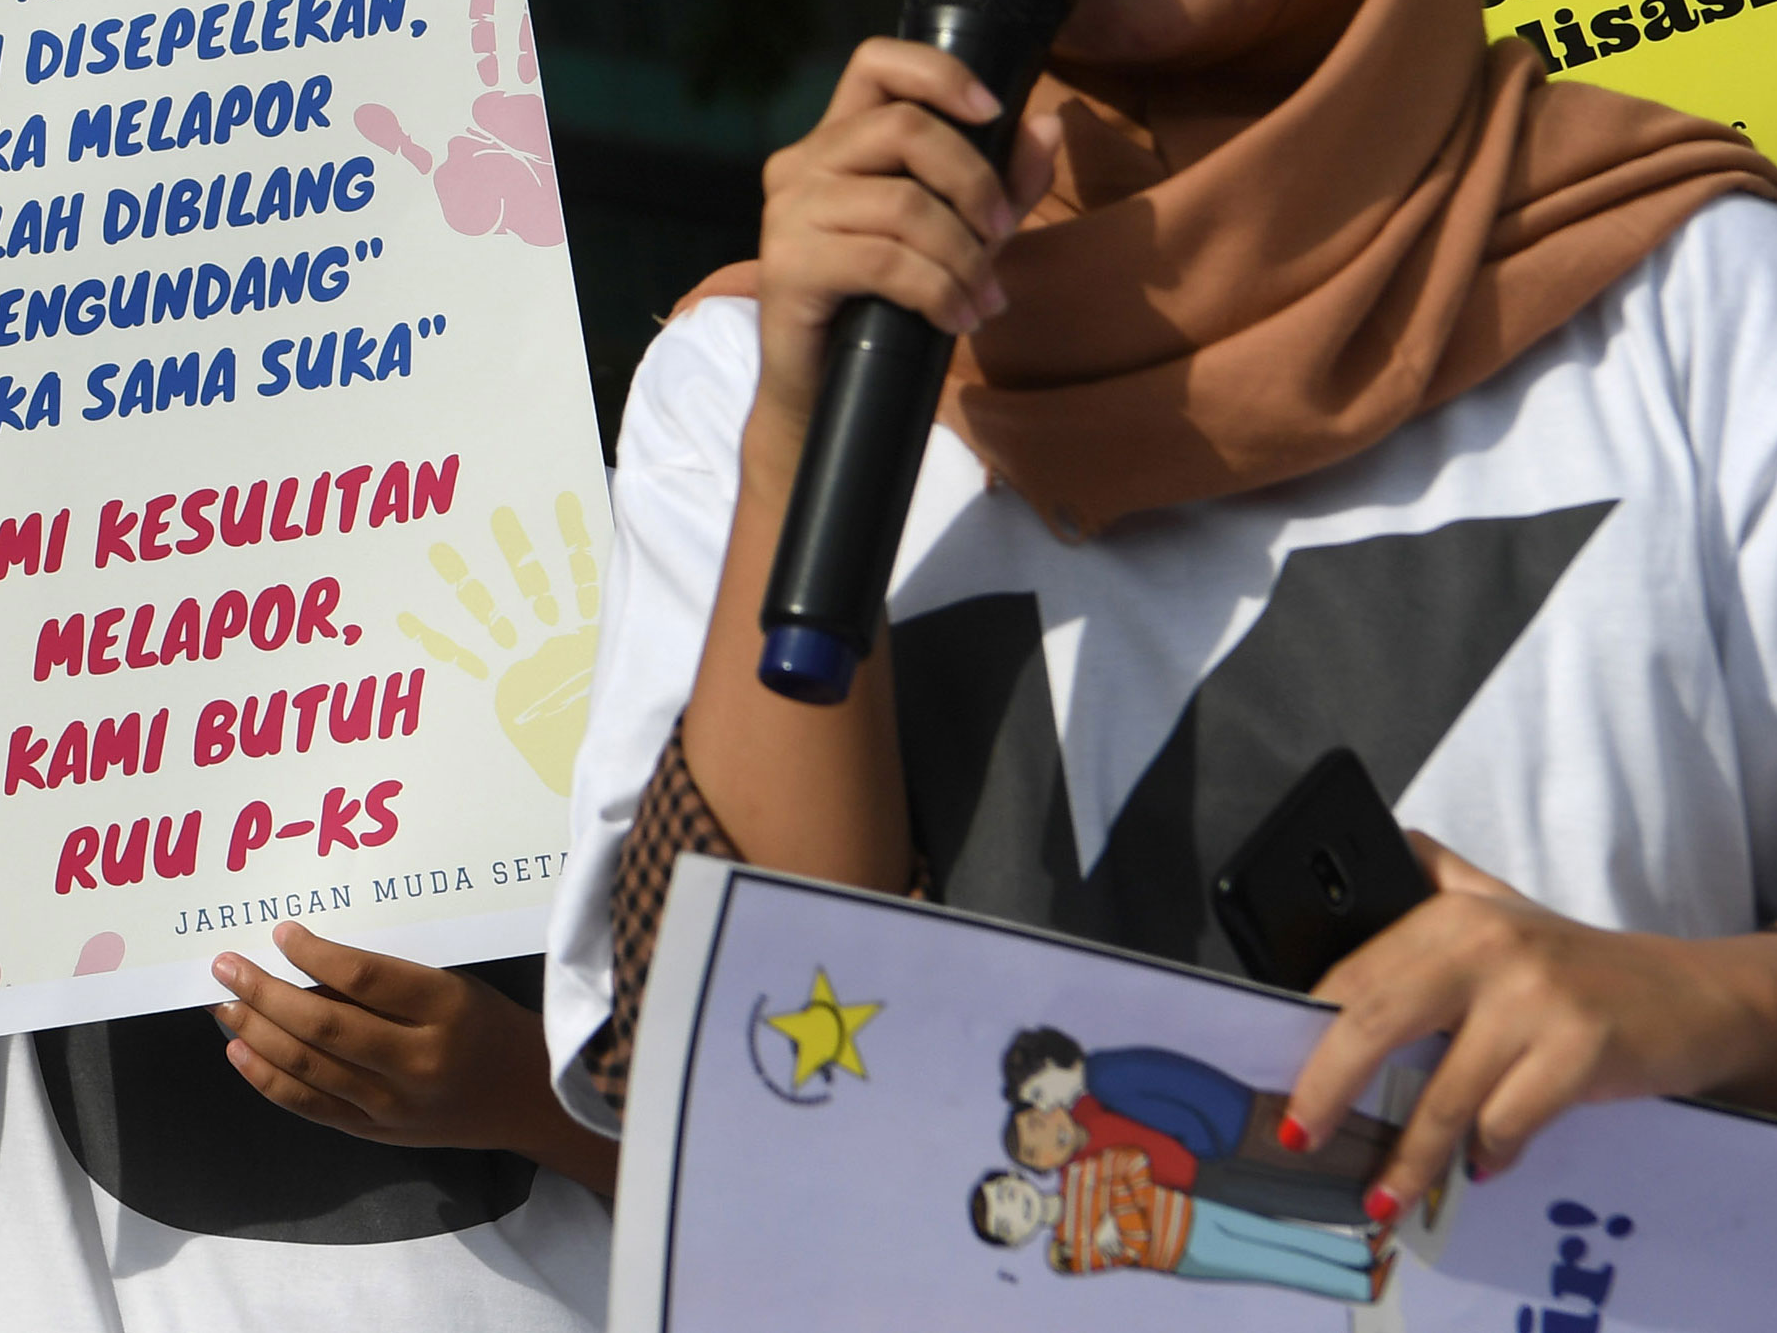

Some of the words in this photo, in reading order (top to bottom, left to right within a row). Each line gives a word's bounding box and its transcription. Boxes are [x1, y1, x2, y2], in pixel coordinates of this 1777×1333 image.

[68, 73, 333, 163] MELAPOR
[103, 155, 376, 245] DIBILANG
[81, 347, 236, 421] SAMA
[257, 313, 447, 397] SUKA"
[95, 454, 461, 569] KESULITAN
[34, 576, 363, 682] MELAPOR,
[4, 707, 170, 797] KAMI
[194, 667, 426, 768] BUTUH
[55, 809, 203, 895] RUU
[226, 779, 404, 873] P-KS
[174, 884, 352, 935] JARINGAN
[372, 866, 473, 903] MUDA
